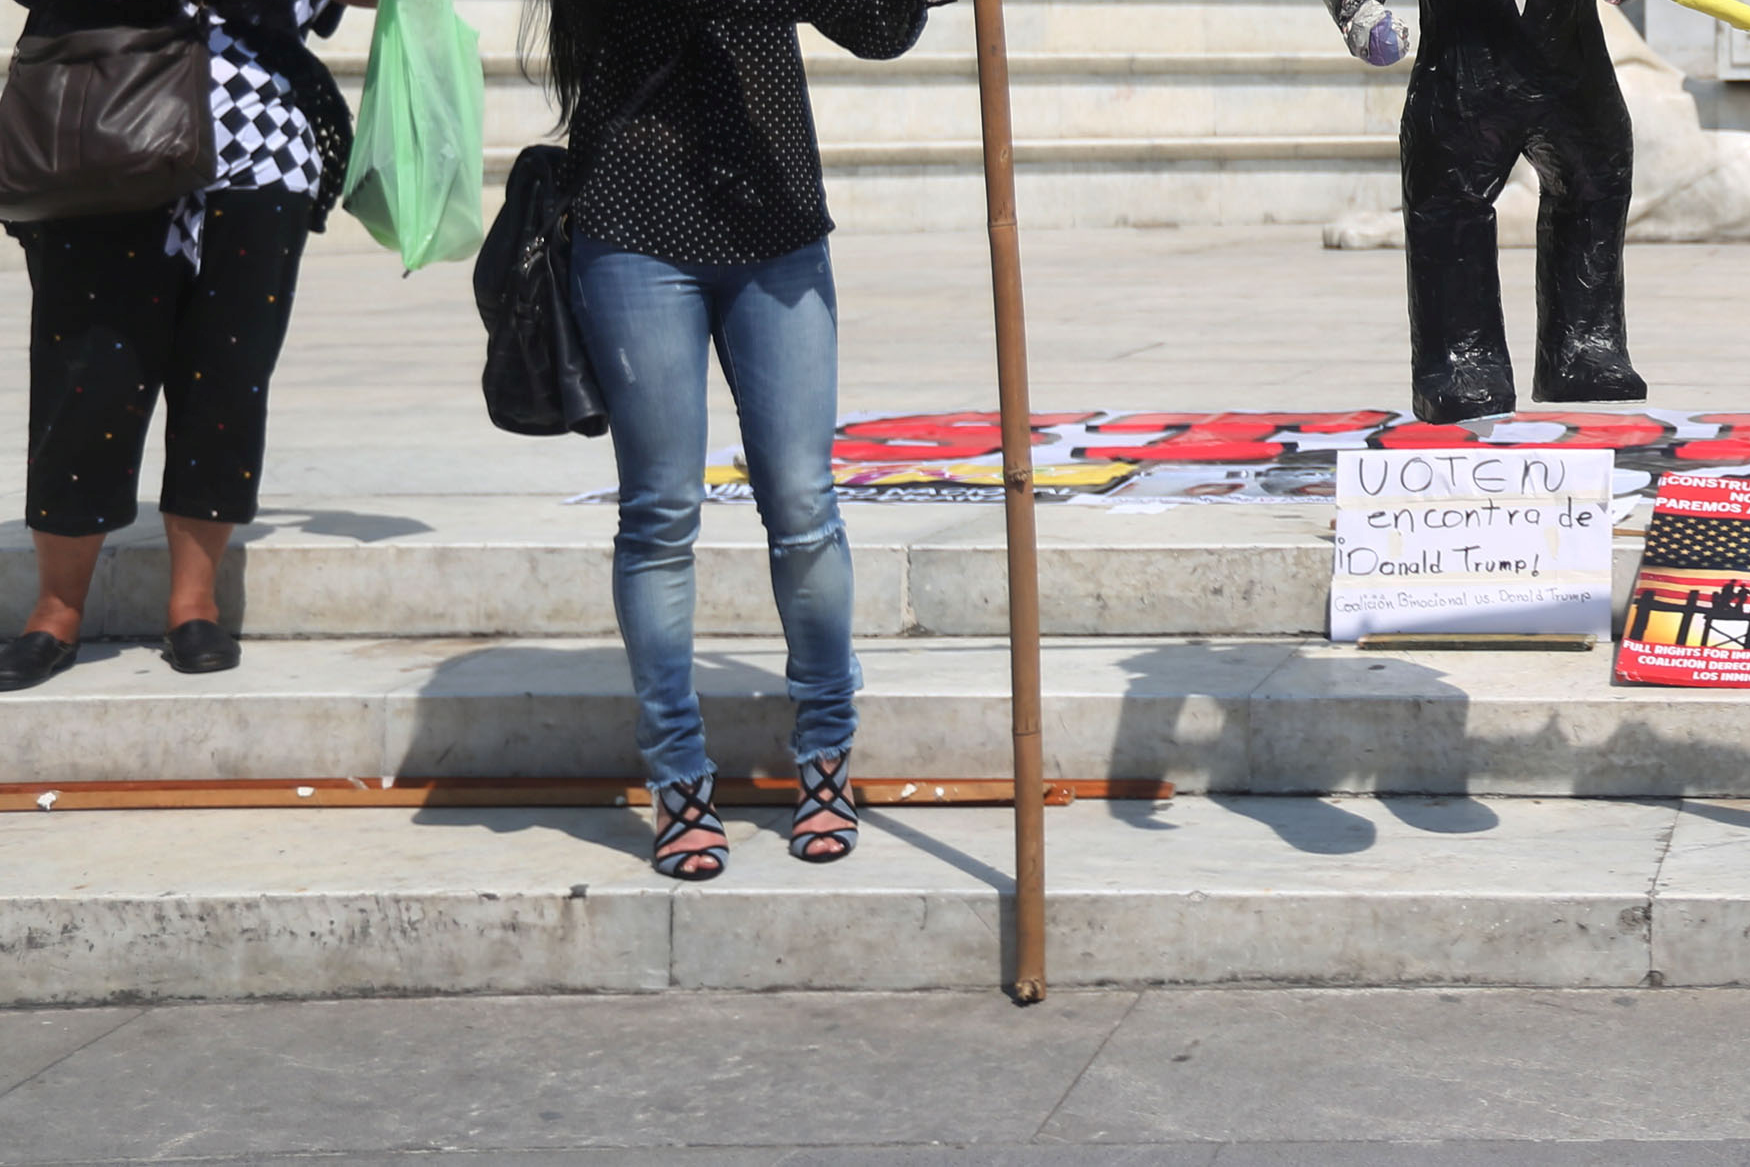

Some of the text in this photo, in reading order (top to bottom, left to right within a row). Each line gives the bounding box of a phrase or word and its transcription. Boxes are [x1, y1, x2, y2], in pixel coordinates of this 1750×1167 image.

[1359, 456, 1565, 496] VOTEN
[1559, 496, 1593, 528] de
[1655, 497, 1742, 514] PAREMOS
[1453, 545, 1539, 577] Trump!
[1546, 587, 1591, 603] Trump
[1623, 640, 1652, 653] FULL
[1654, 645, 1701, 657] RIGHTS
[1703, 648, 1729, 659] FOR
[1638, 655, 1707, 669] COALICION
[1692, 671, 1719, 681] LOS
